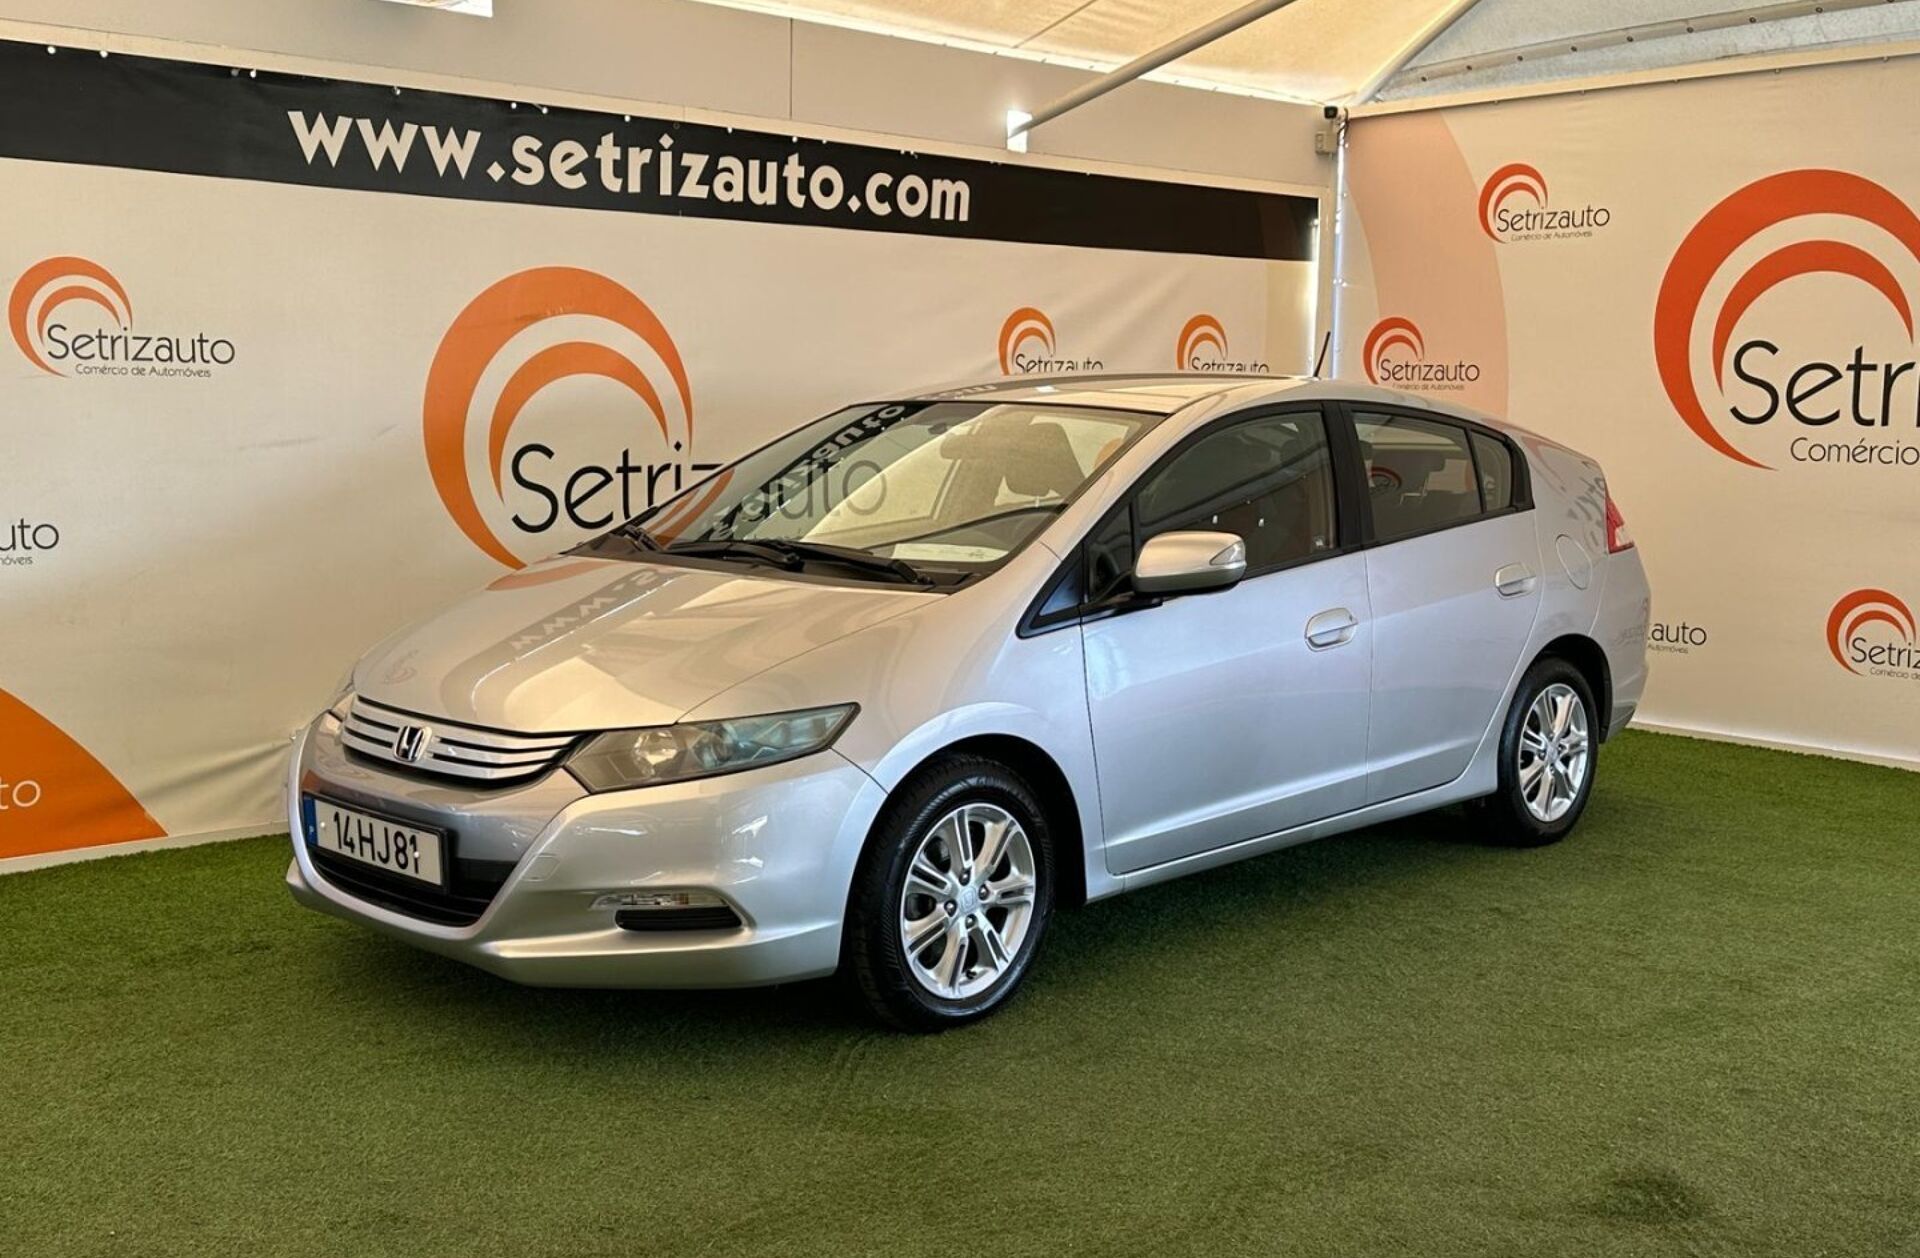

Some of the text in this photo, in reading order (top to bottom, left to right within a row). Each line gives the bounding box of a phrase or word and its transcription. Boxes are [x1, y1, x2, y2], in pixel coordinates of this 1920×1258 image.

[287, 110, 971, 222] www.setrizauto.com
[1497, 204, 1610, 233] Setrizauto
[47, 323, 235, 364] Setrizauto
[75, 363, 212, 378] Comércio de Automóveis
[1380, 358, 1480, 382] Setrizauto
[1790, 436, 1920, 466] Comércio
[1648, 621, 1707, 646] auto
[333, 811, 419, 875] 14HJ81
